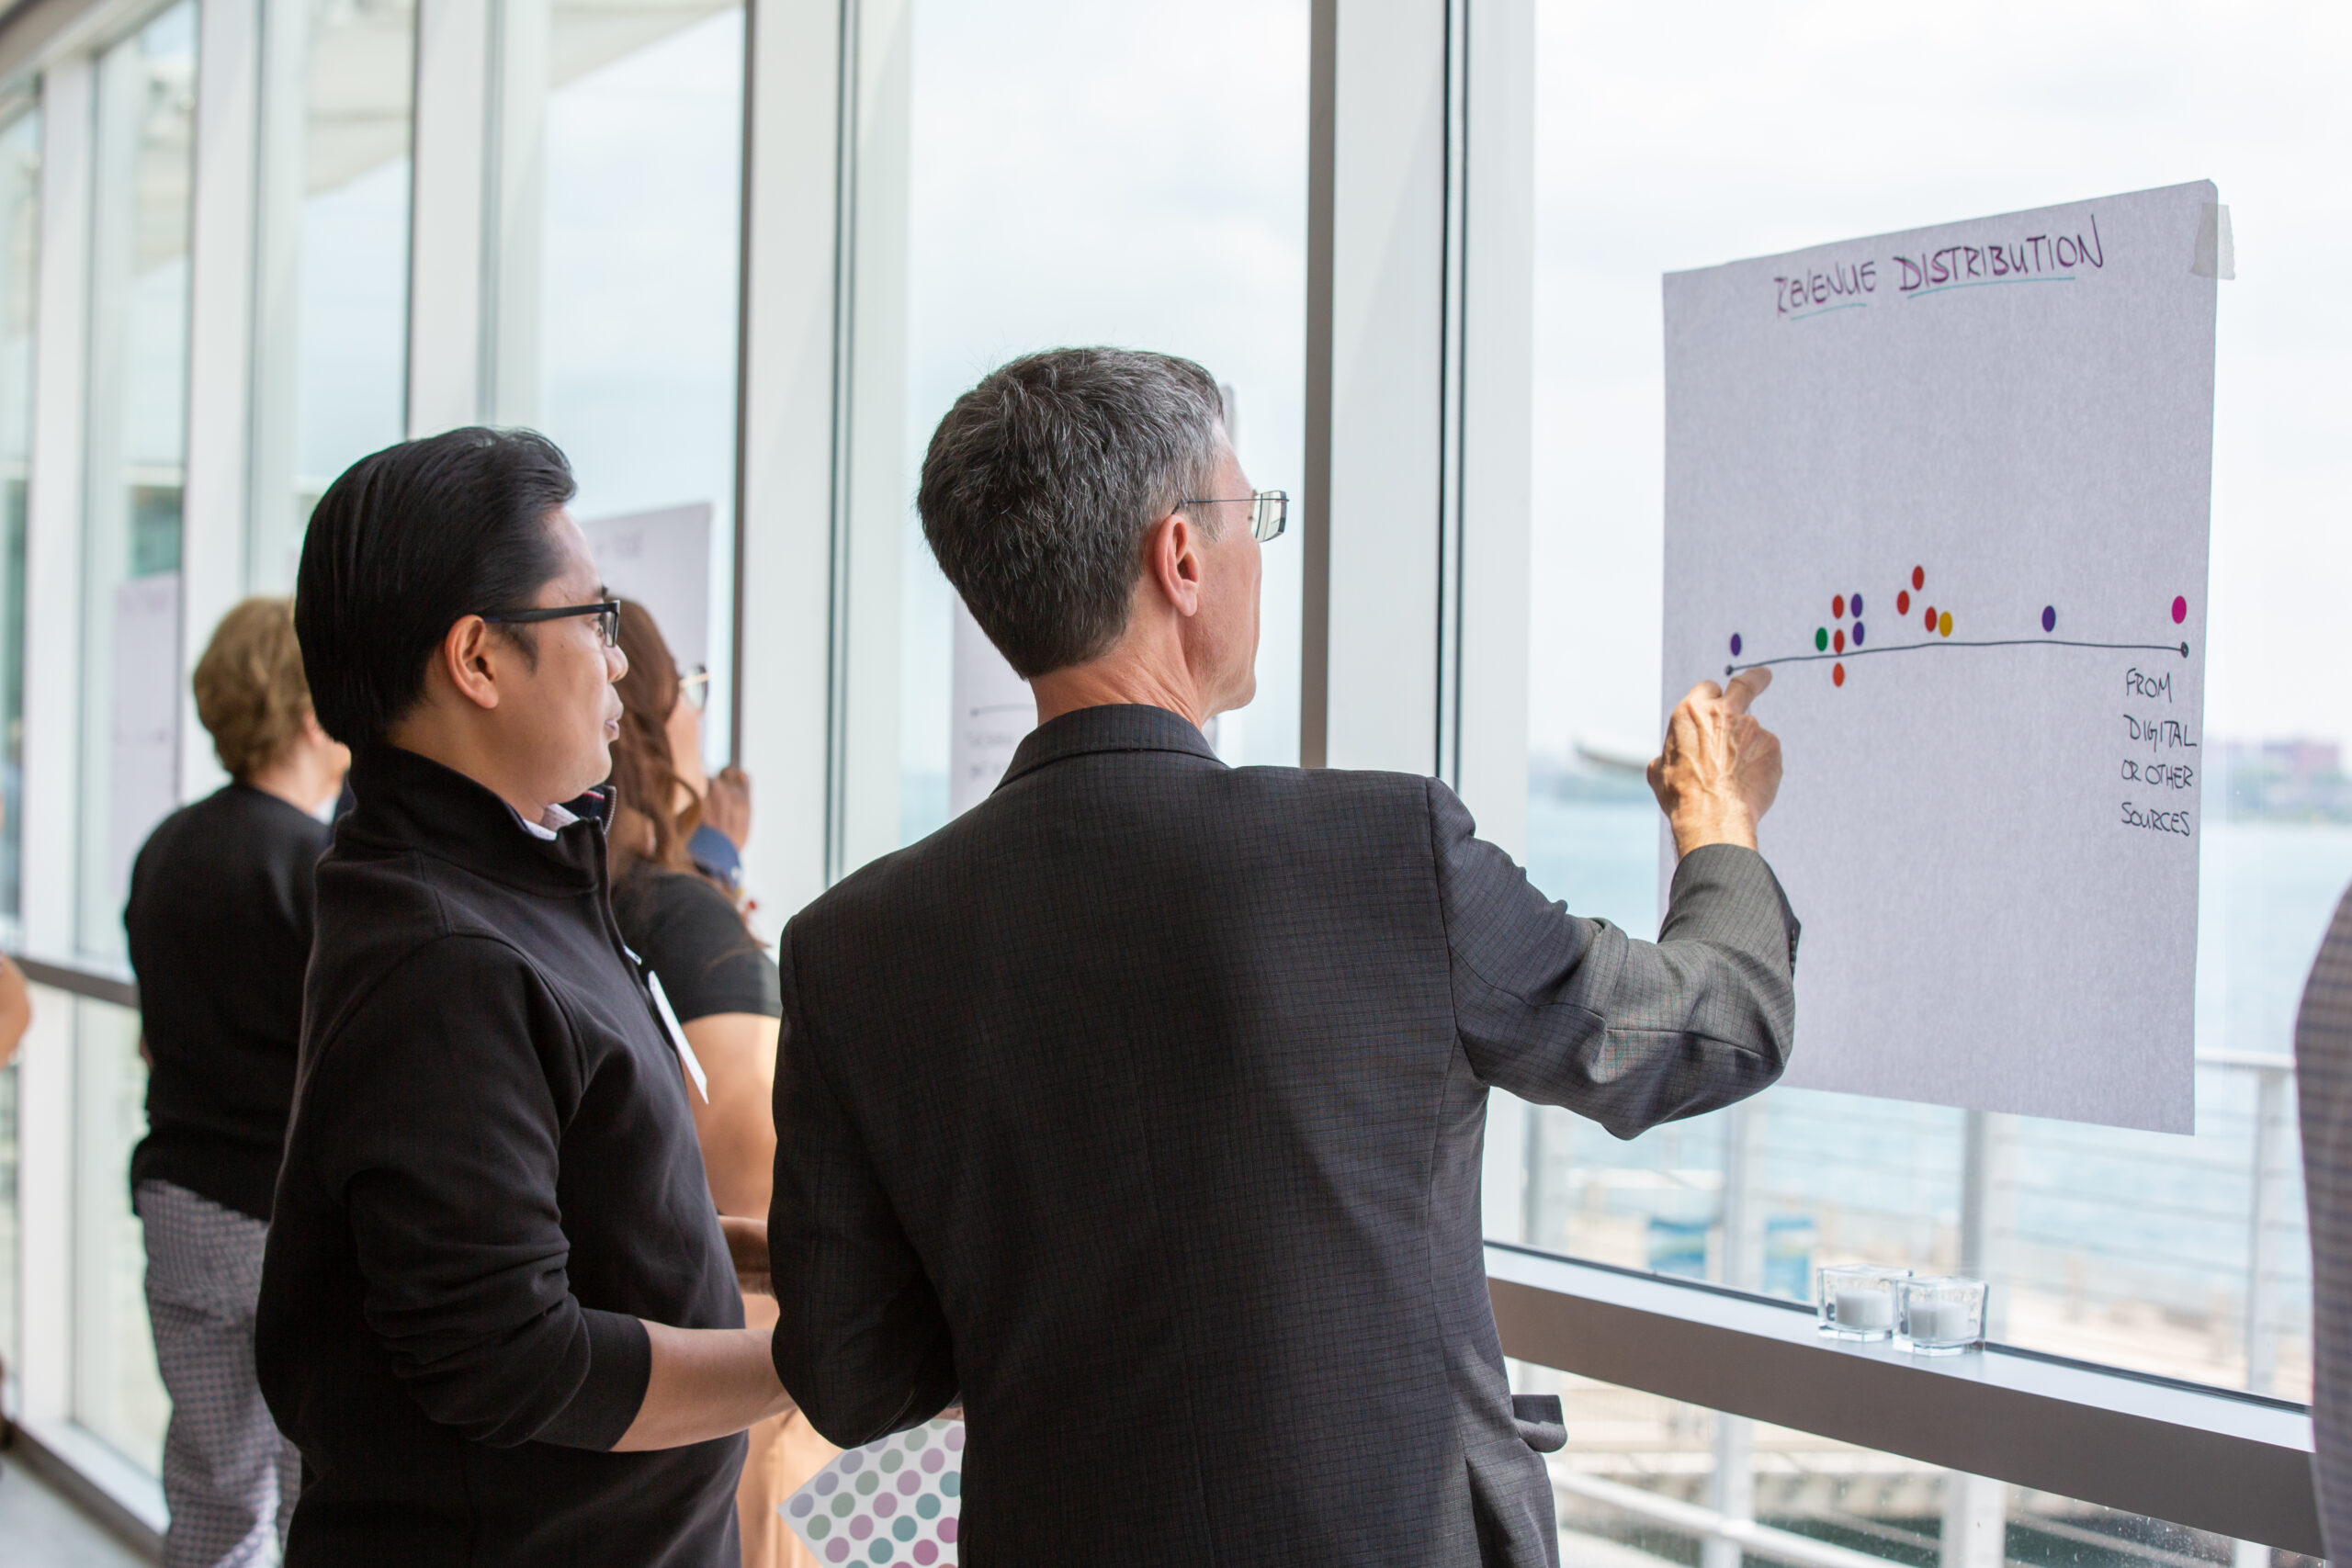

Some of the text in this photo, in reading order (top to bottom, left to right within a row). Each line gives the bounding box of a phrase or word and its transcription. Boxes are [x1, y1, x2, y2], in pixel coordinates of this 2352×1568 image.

[1773, 214, 2104, 317] REVENUE DISTRIBUTION
[2125, 668, 2172, 704] FROM
[2122, 714, 2197, 753] DIGITAL
[2121, 759, 2193, 790] OR OTHER
[2121, 802, 2190, 837] SOURCES
